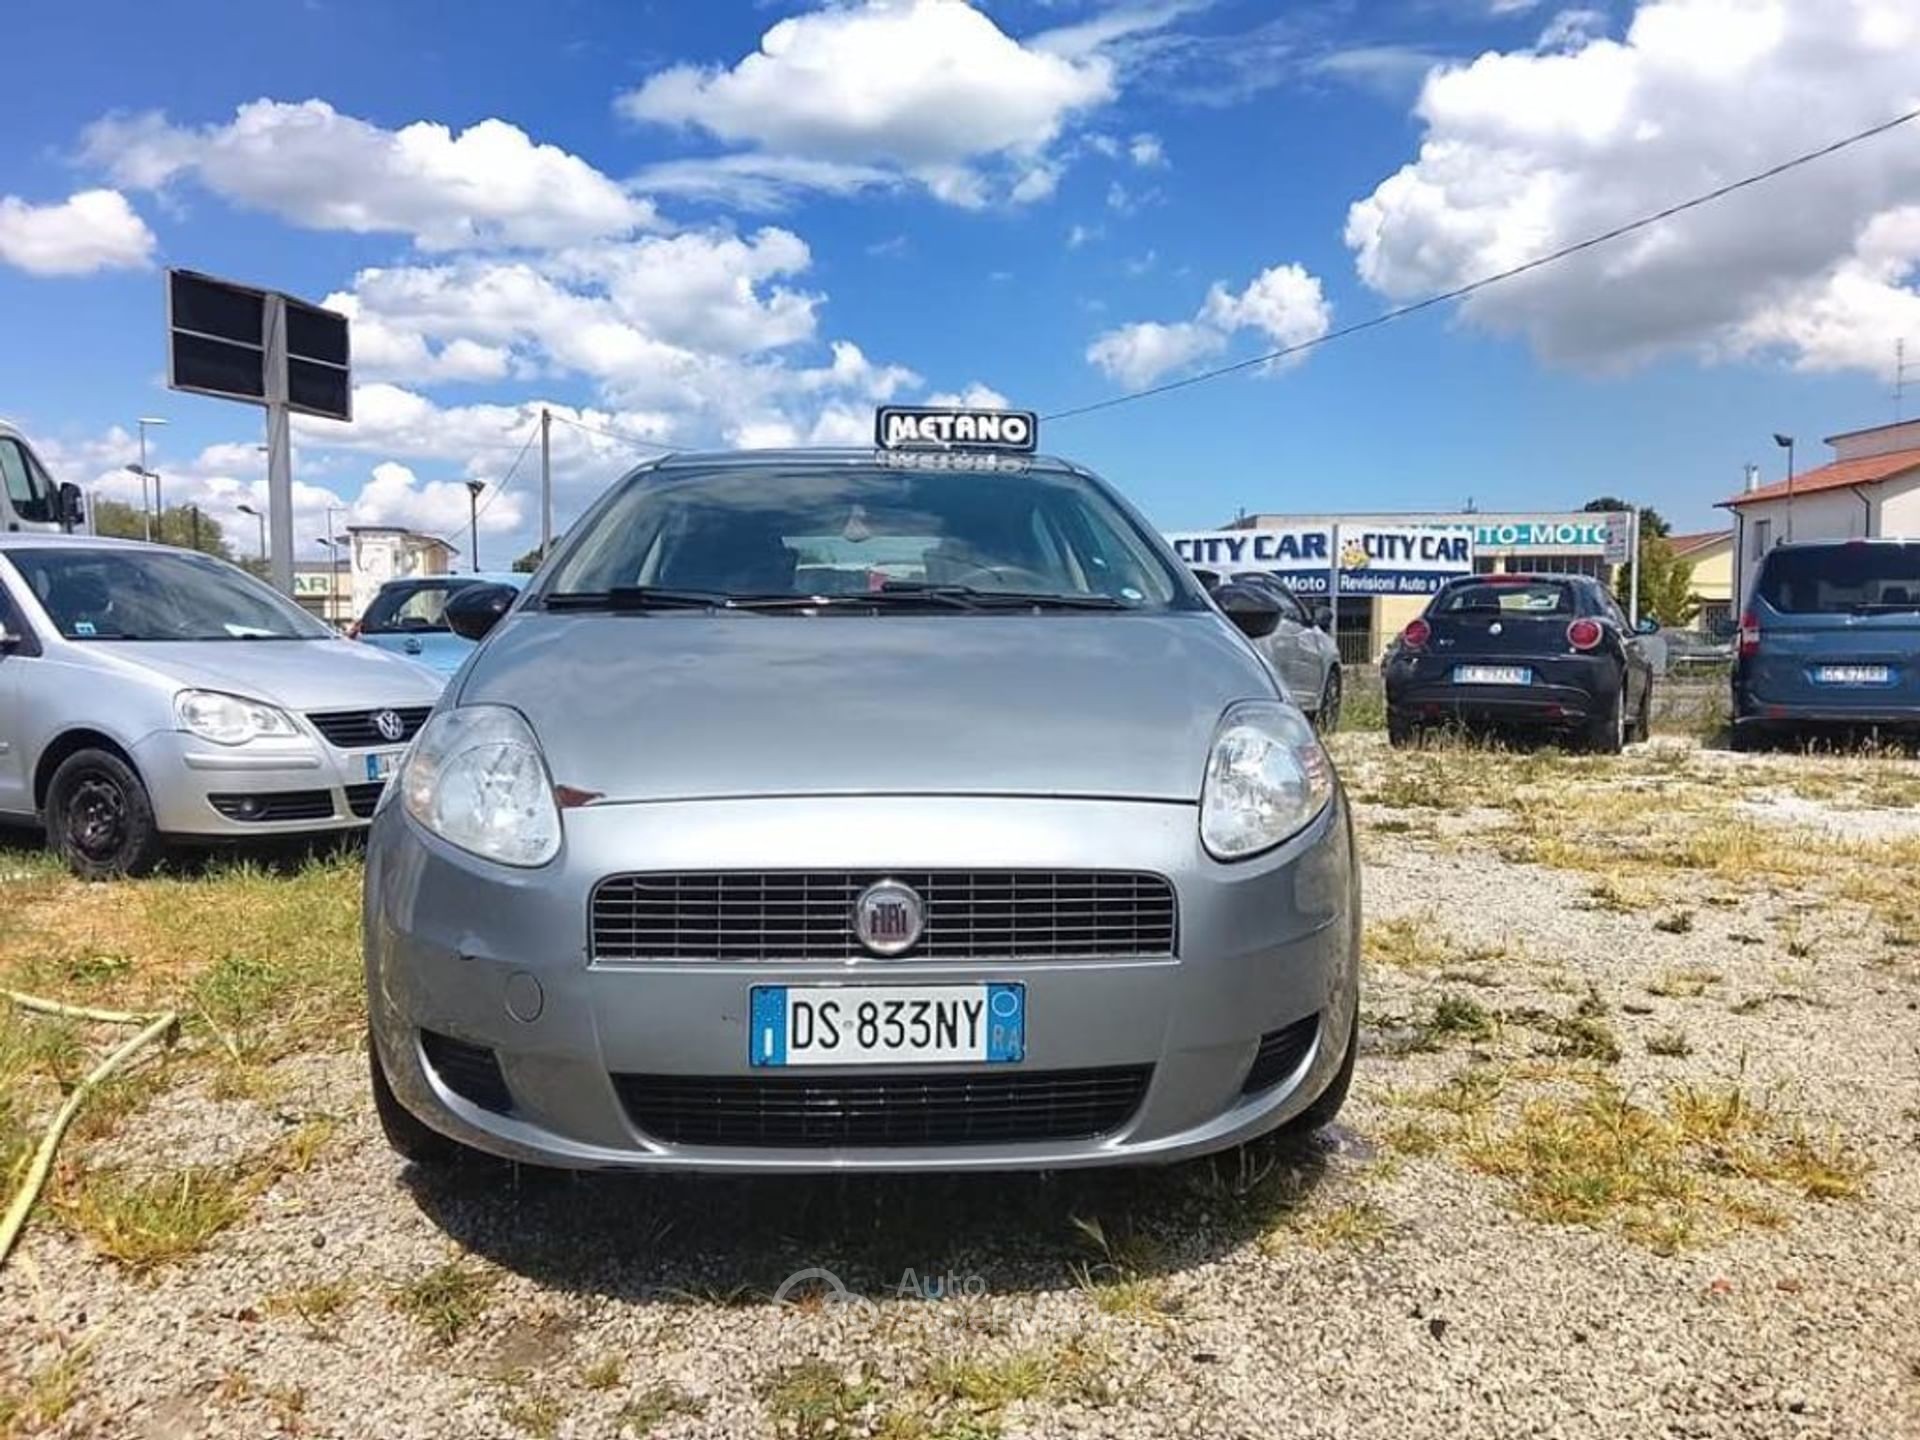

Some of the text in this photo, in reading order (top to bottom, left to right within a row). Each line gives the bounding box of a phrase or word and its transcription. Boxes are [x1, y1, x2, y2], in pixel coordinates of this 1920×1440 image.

[887, 415, 1027, 445] METANO
[1174, 533, 1328, 563] CITY CAR
[1363, 533, 1469, 562] CITY CAR
[1283, 576, 1326, 592] Moto
[1341, 575, 1396, 592] Revisioni
[1399, 576, 1427, 592] Auto
[1429, 580, 1438, 592] e
[791, 1001, 841, 1050] DS
[857, 1000, 984, 1049] 833NY
